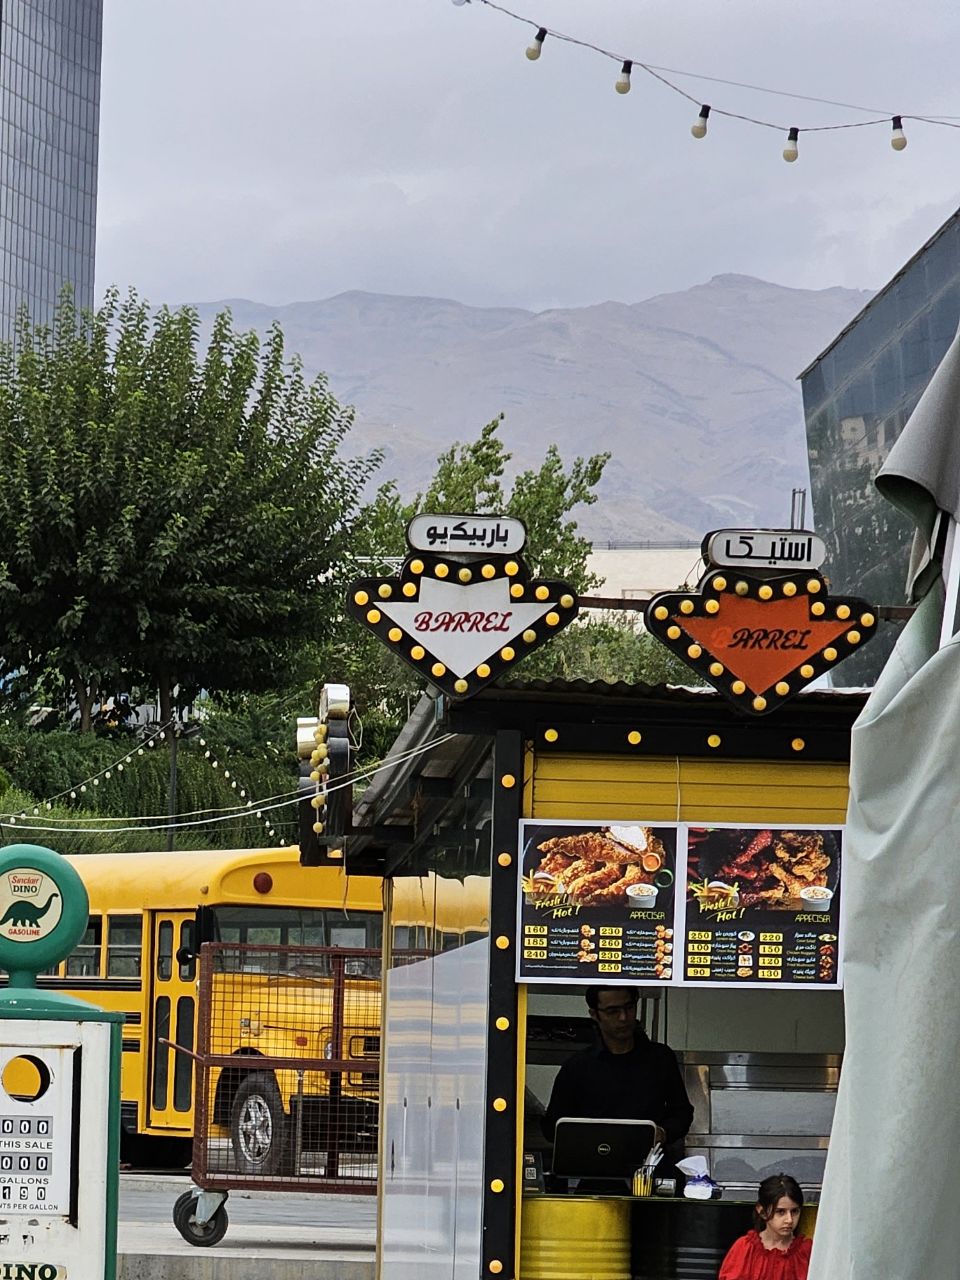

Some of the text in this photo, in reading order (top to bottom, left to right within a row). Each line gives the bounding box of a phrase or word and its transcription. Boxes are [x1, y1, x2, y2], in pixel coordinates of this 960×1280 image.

[426, 521, 510, 547] باربیکیو
[725, 536, 812, 562] استیک
[414, 611, 512, 633] BARREL
[12, 875, 39, 885] Sinclair
[13, 885, 38, 893] DINO
[526, 926, 545, 934] 160
[601, 927, 621, 935] 230
[690, 932, 710, 940] 250
[761, 934, 781, 942] 220
[526, 938, 545, 946] 185
[600, 939, 620, 947] 260
[690, 944, 710, 952] 100
[761, 946, 781, 954] 150
[526, 950, 545, 958] 240
[600, 951, 620, 960] 230
[689, 956, 709, 964] 235
[761, 958, 781, 966] 120
[600, 963, 620, 972] 250
[692, 968, 706, 976] 90
[761, 970, 780, 978] 130
[25, 1141, 53, 1150] SALE
[0, 1177, 49, 1185] GALLONS
